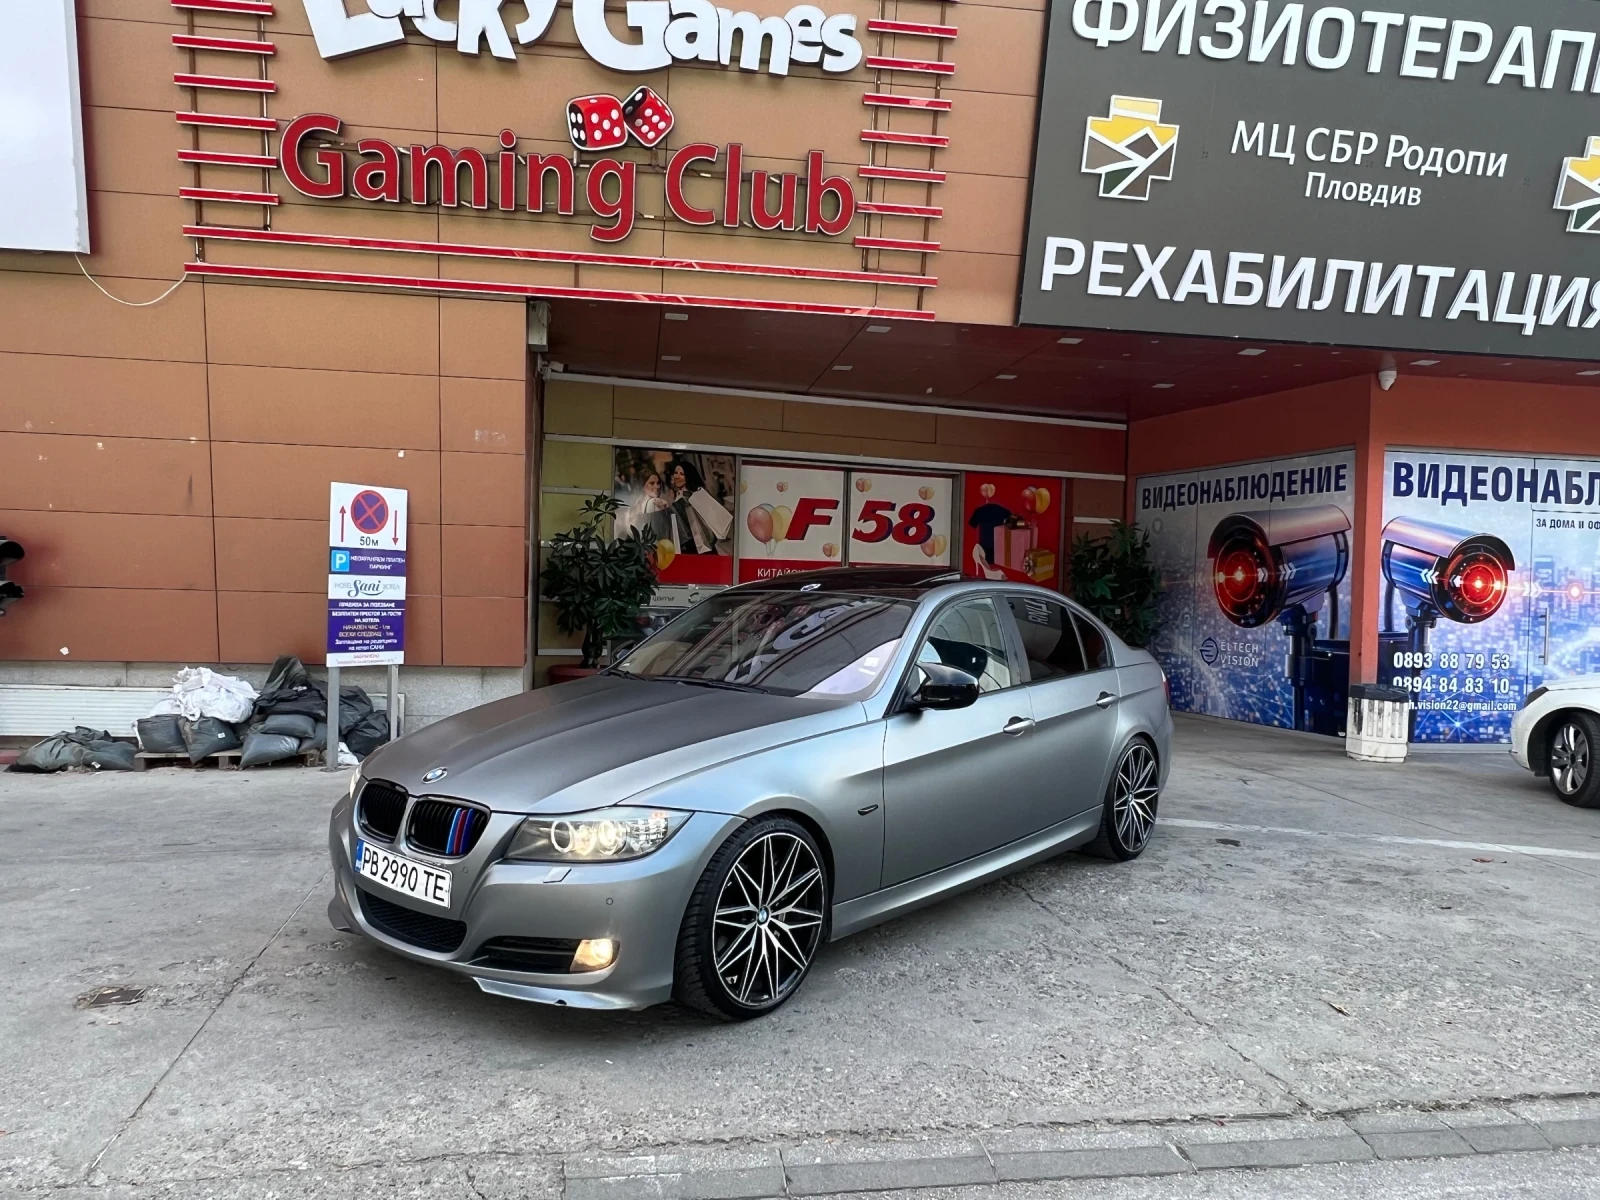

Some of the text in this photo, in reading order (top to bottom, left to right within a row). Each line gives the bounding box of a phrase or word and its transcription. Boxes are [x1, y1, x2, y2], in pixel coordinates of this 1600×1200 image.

[572, 0, 863, 76] Games
[1071, 0, 1600, 94] ФИЗИОТЕРАП
[1231, 120, 1508, 177] МЦ СБР Родопи
[280, 113, 856, 242] Gaming Club
[1305, 171, 1421, 208] Пловдив
[1142, 464, 1348, 512] ВИДЕОНАБЛЮДЕНИЕ
[784, 497, 936, 546] F 58
[1536, 518, 1547, 528] ЗА
[1549, 518, 1575, 529] ДОМА
[347, 579, 381, 597] Sani
[1221, 641, 1259, 653] ELTECH
[1221, 655, 1259, 668] VISION
[1393, 652, 1510, 670] 0893 88 79 53
[1439, 676, 1458, 693] 84
[1465, 677, 1484, 693] 83
[1491, 678, 1510, 693] 10
[1409, 699, 1517, 713] h.vision22@gmail.com
[362, 846, 446, 902] PB 2990 TE
